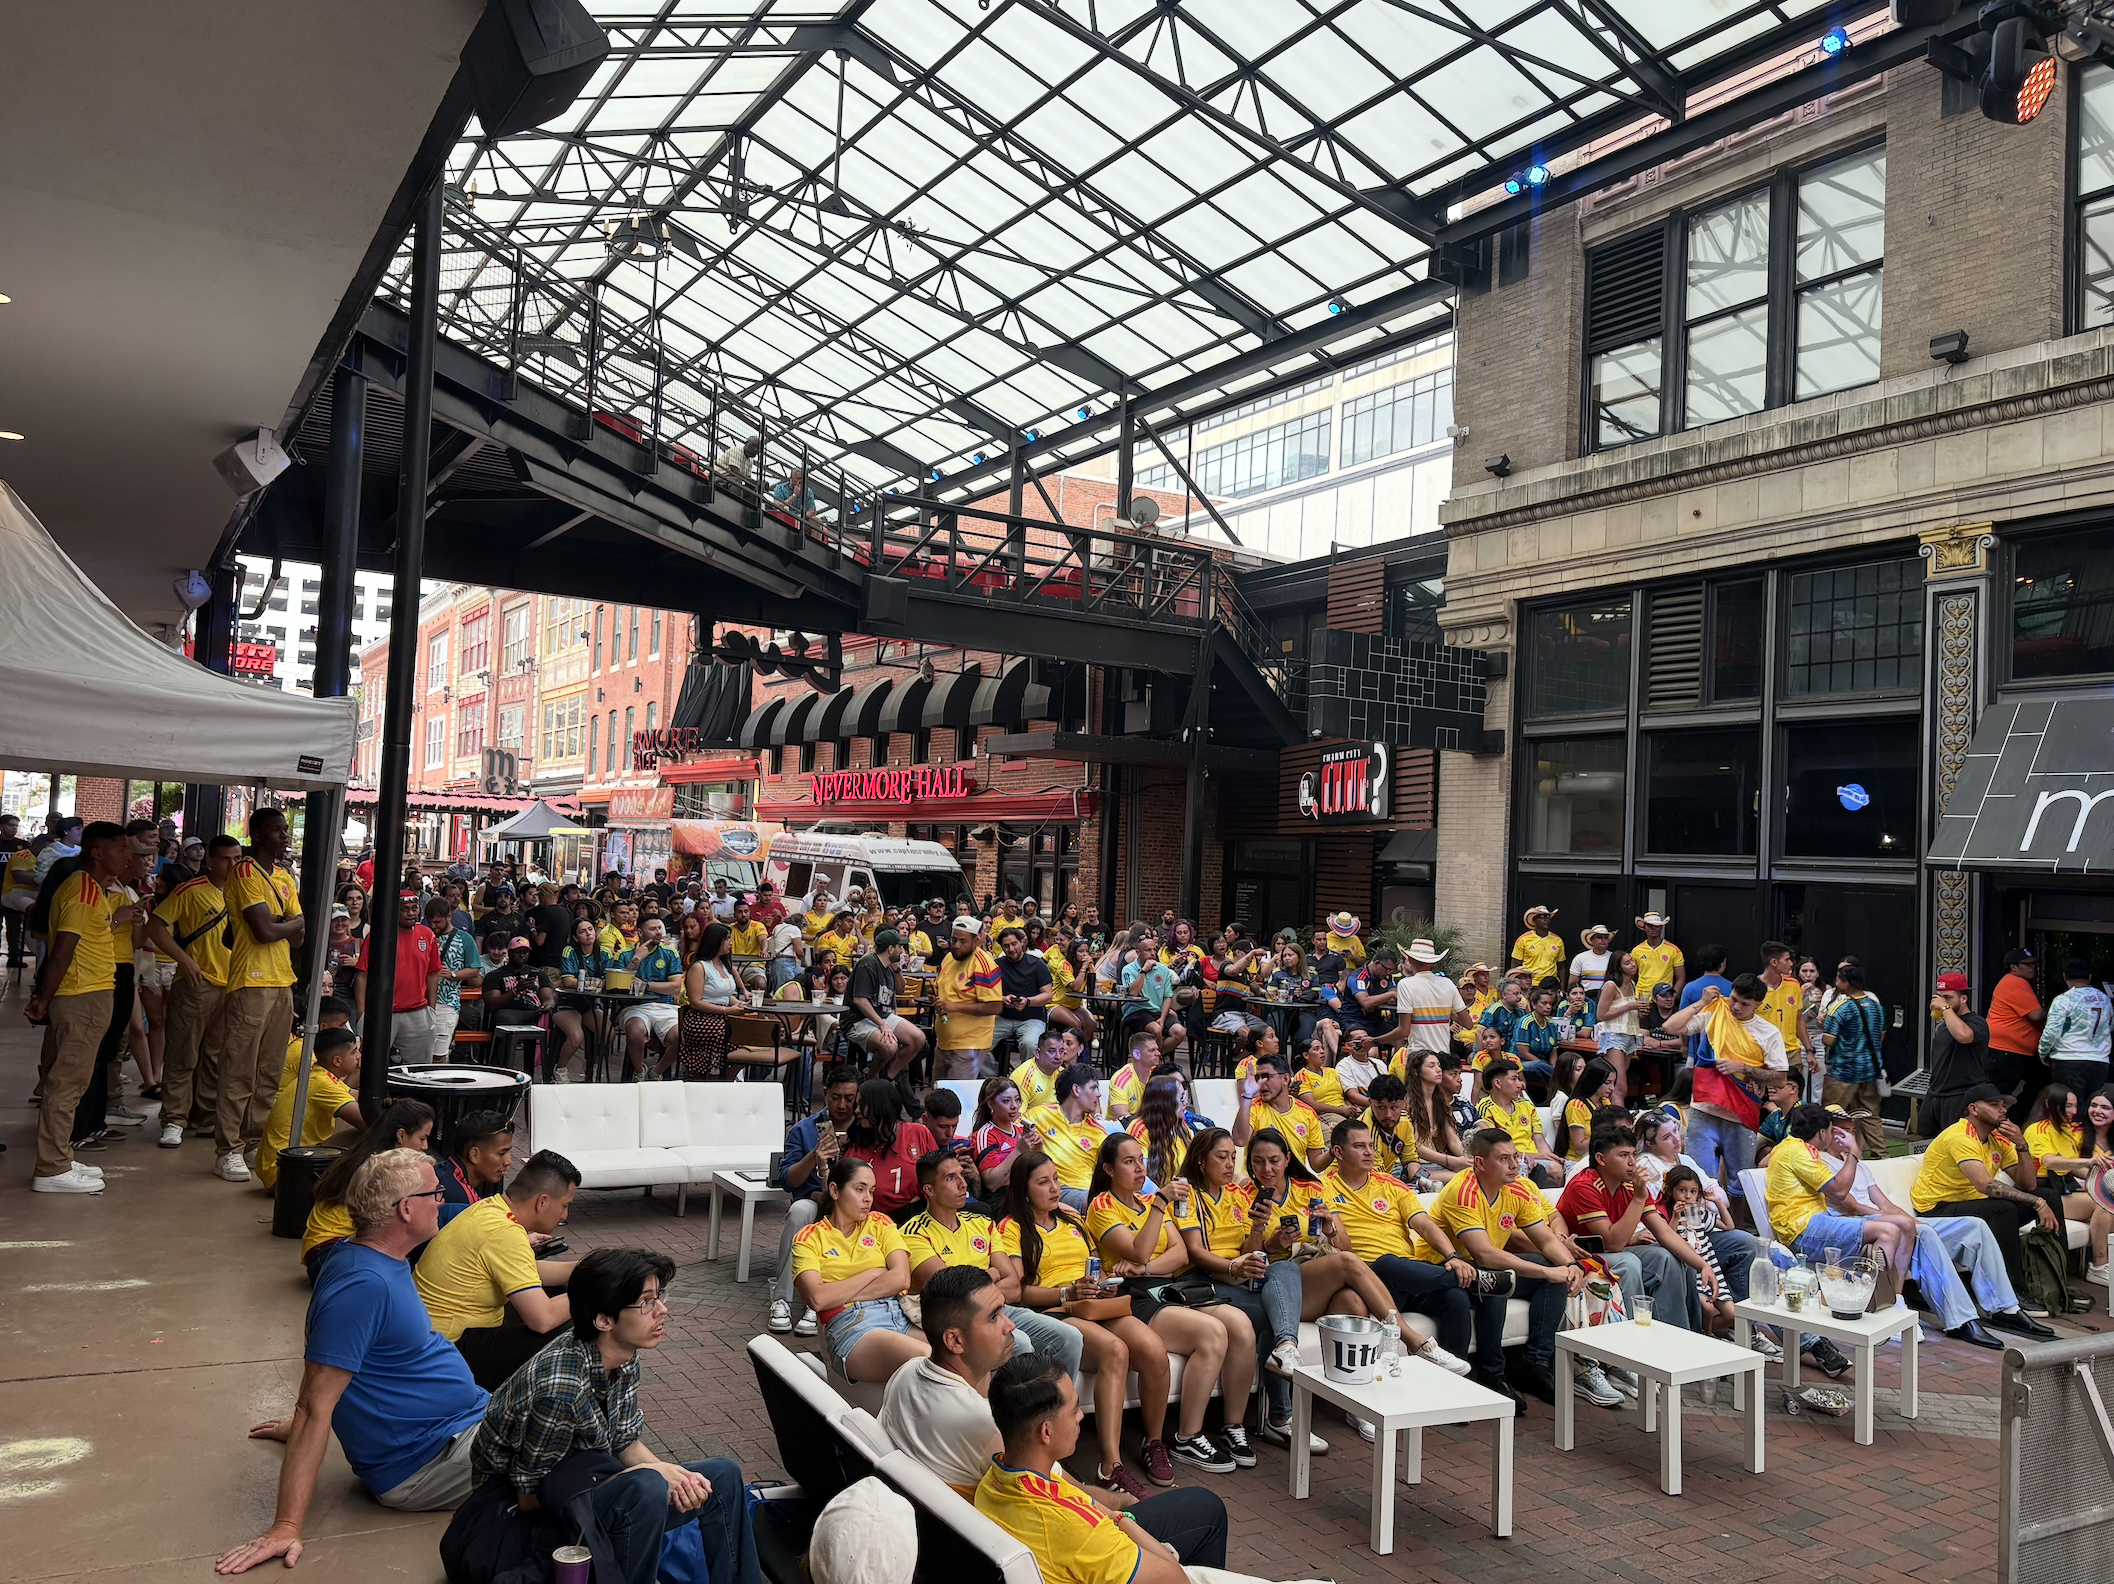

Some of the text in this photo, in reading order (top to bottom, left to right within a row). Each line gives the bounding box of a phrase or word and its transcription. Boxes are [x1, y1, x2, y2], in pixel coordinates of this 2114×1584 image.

[1322, 748, 1362, 763] CHARM CITY
[810, 767, 968, 806] NEVERMORE HALL
[1776, 1008, 1784, 1022] 7
[2091, 1007, 2102, 1039] 7
